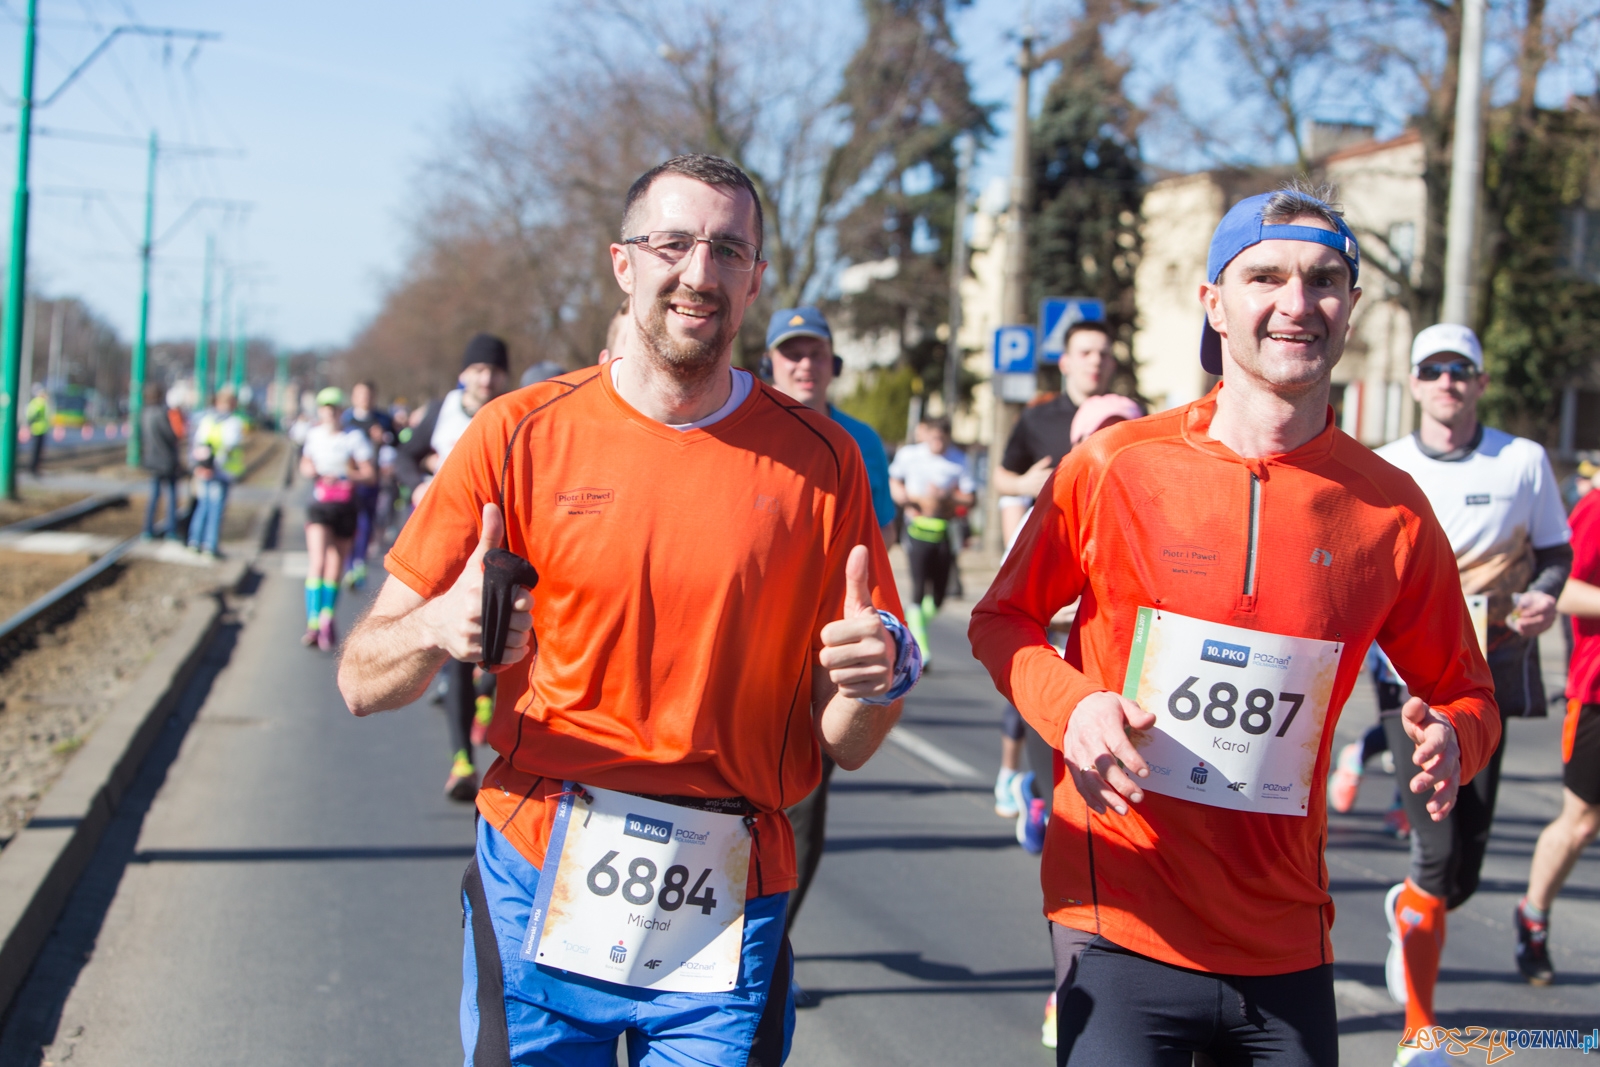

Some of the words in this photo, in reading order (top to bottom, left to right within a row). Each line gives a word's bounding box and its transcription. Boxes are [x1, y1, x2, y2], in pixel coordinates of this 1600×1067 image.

[999, 329, 1029, 372] P
[558, 494, 579, 502] Piotr
[1163, 549, 1184, 558] Piotr
[1136, 613, 1146, 644] 26.03.2017
[1206, 646, 1220, 658] 10.
[1221, 649, 1246, 662] PKO
[1168, 675, 1305, 738] 6887
[1212, 736, 1250, 754] Karol
[629, 820, 643, 833] 10.
[644, 823, 668, 838] PKO
[586, 850, 717, 915] 6884
[533, 908, 542, 922] M36
[628, 912, 672, 932] Michał
